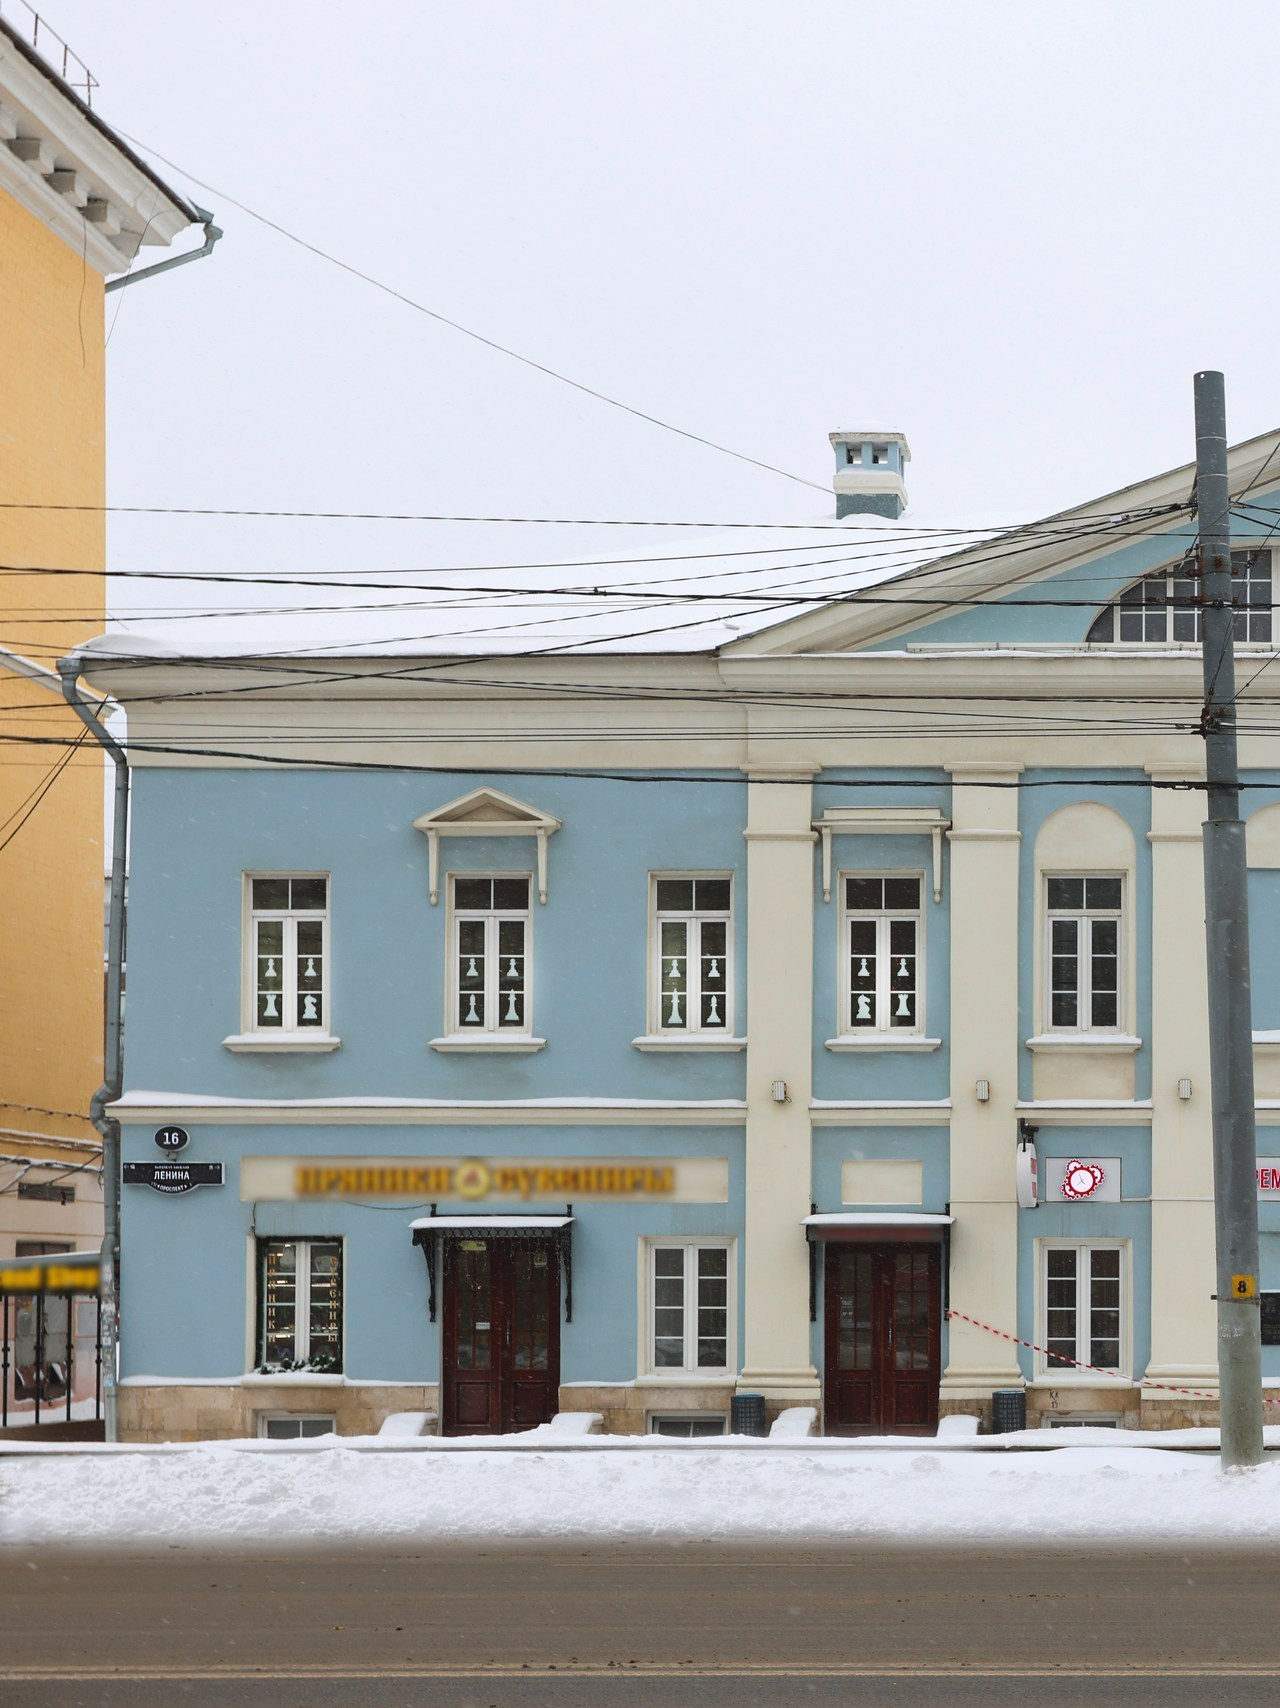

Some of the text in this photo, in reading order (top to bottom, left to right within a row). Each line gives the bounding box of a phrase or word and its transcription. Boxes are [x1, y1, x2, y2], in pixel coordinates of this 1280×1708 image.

[162, 1131, 180, 1146] 16
[154, 1171, 190, 1180] ЛЕНИНА
[159, 1184, 184, 1192] ПРОСПЕКТ
[1237, 1280, 1248, 1294] 8
